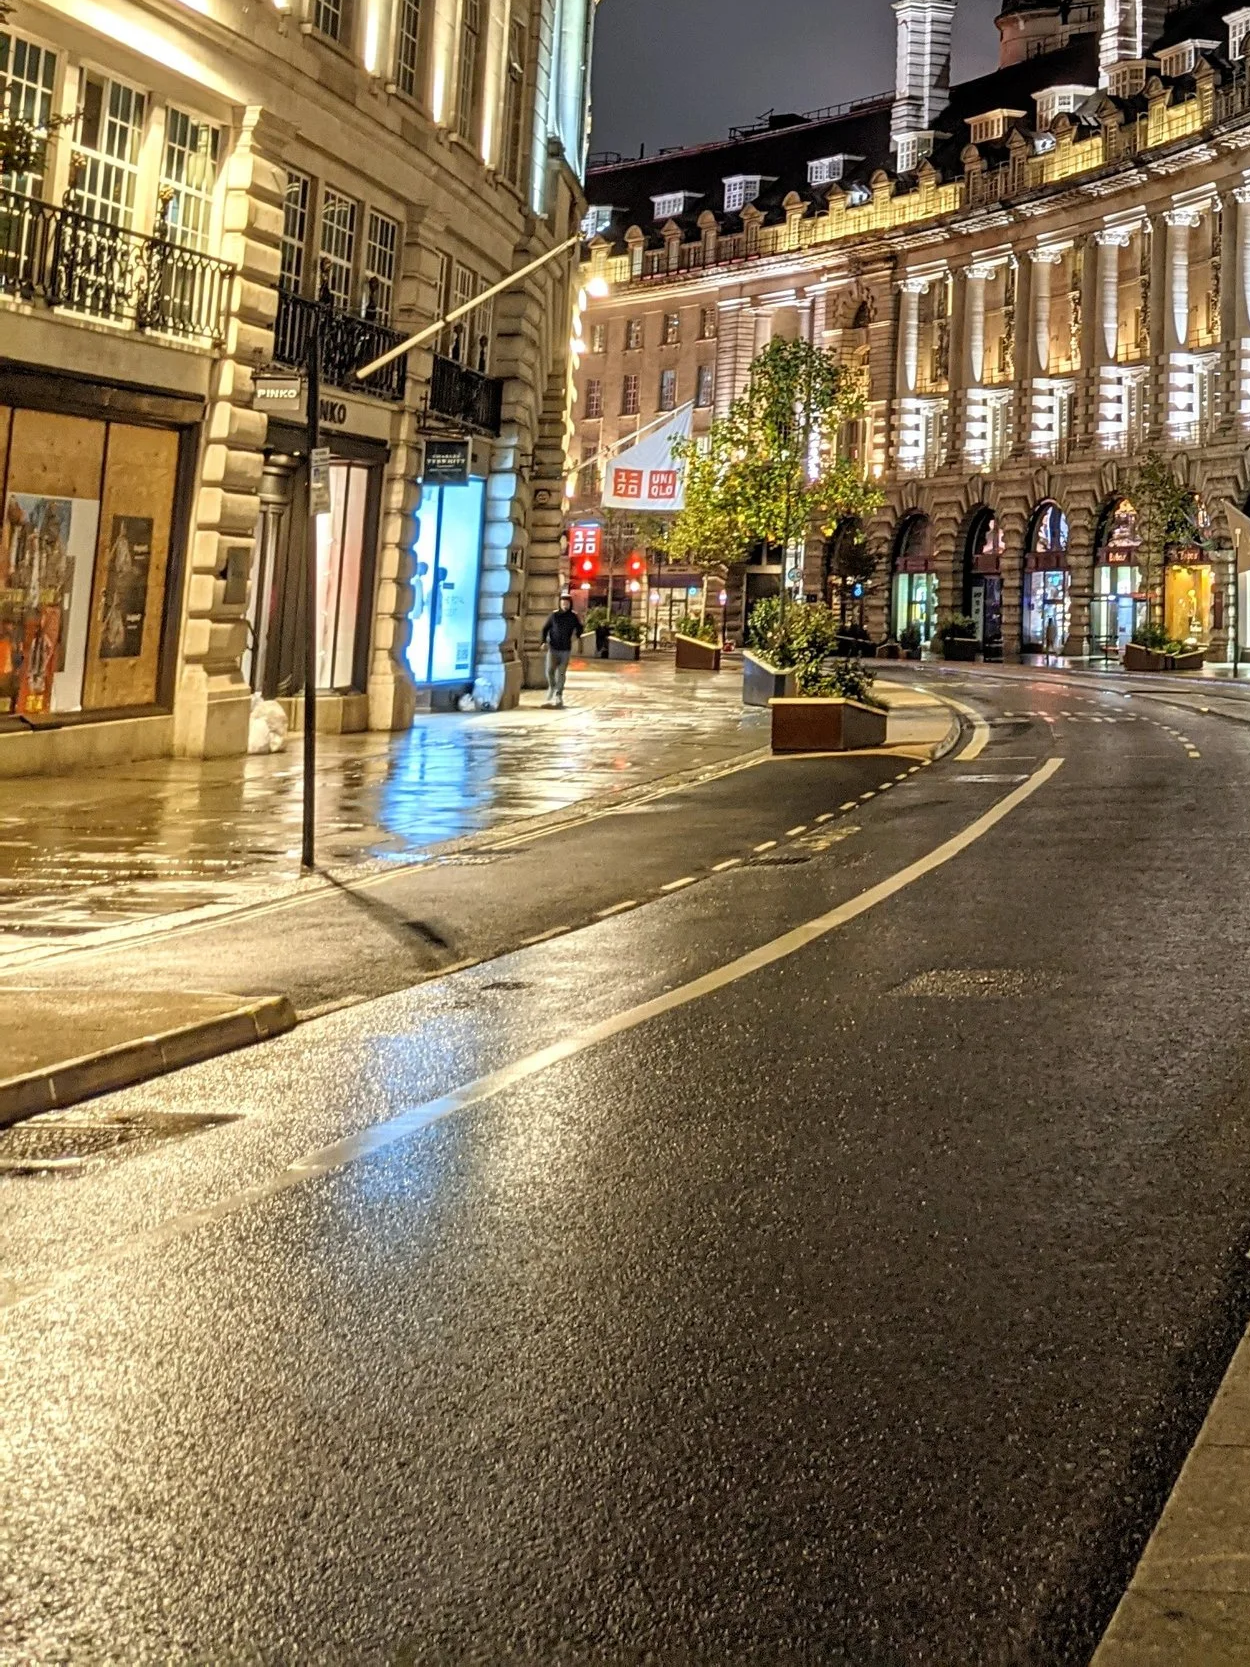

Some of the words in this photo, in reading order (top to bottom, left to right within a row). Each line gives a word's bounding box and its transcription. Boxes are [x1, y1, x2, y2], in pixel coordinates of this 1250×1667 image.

[257, 388, 298, 399] PINKO
[319, 399, 347, 425] NKO
[652, 473, 673, 484] UNI
[651, 485, 673, 496] QLO
